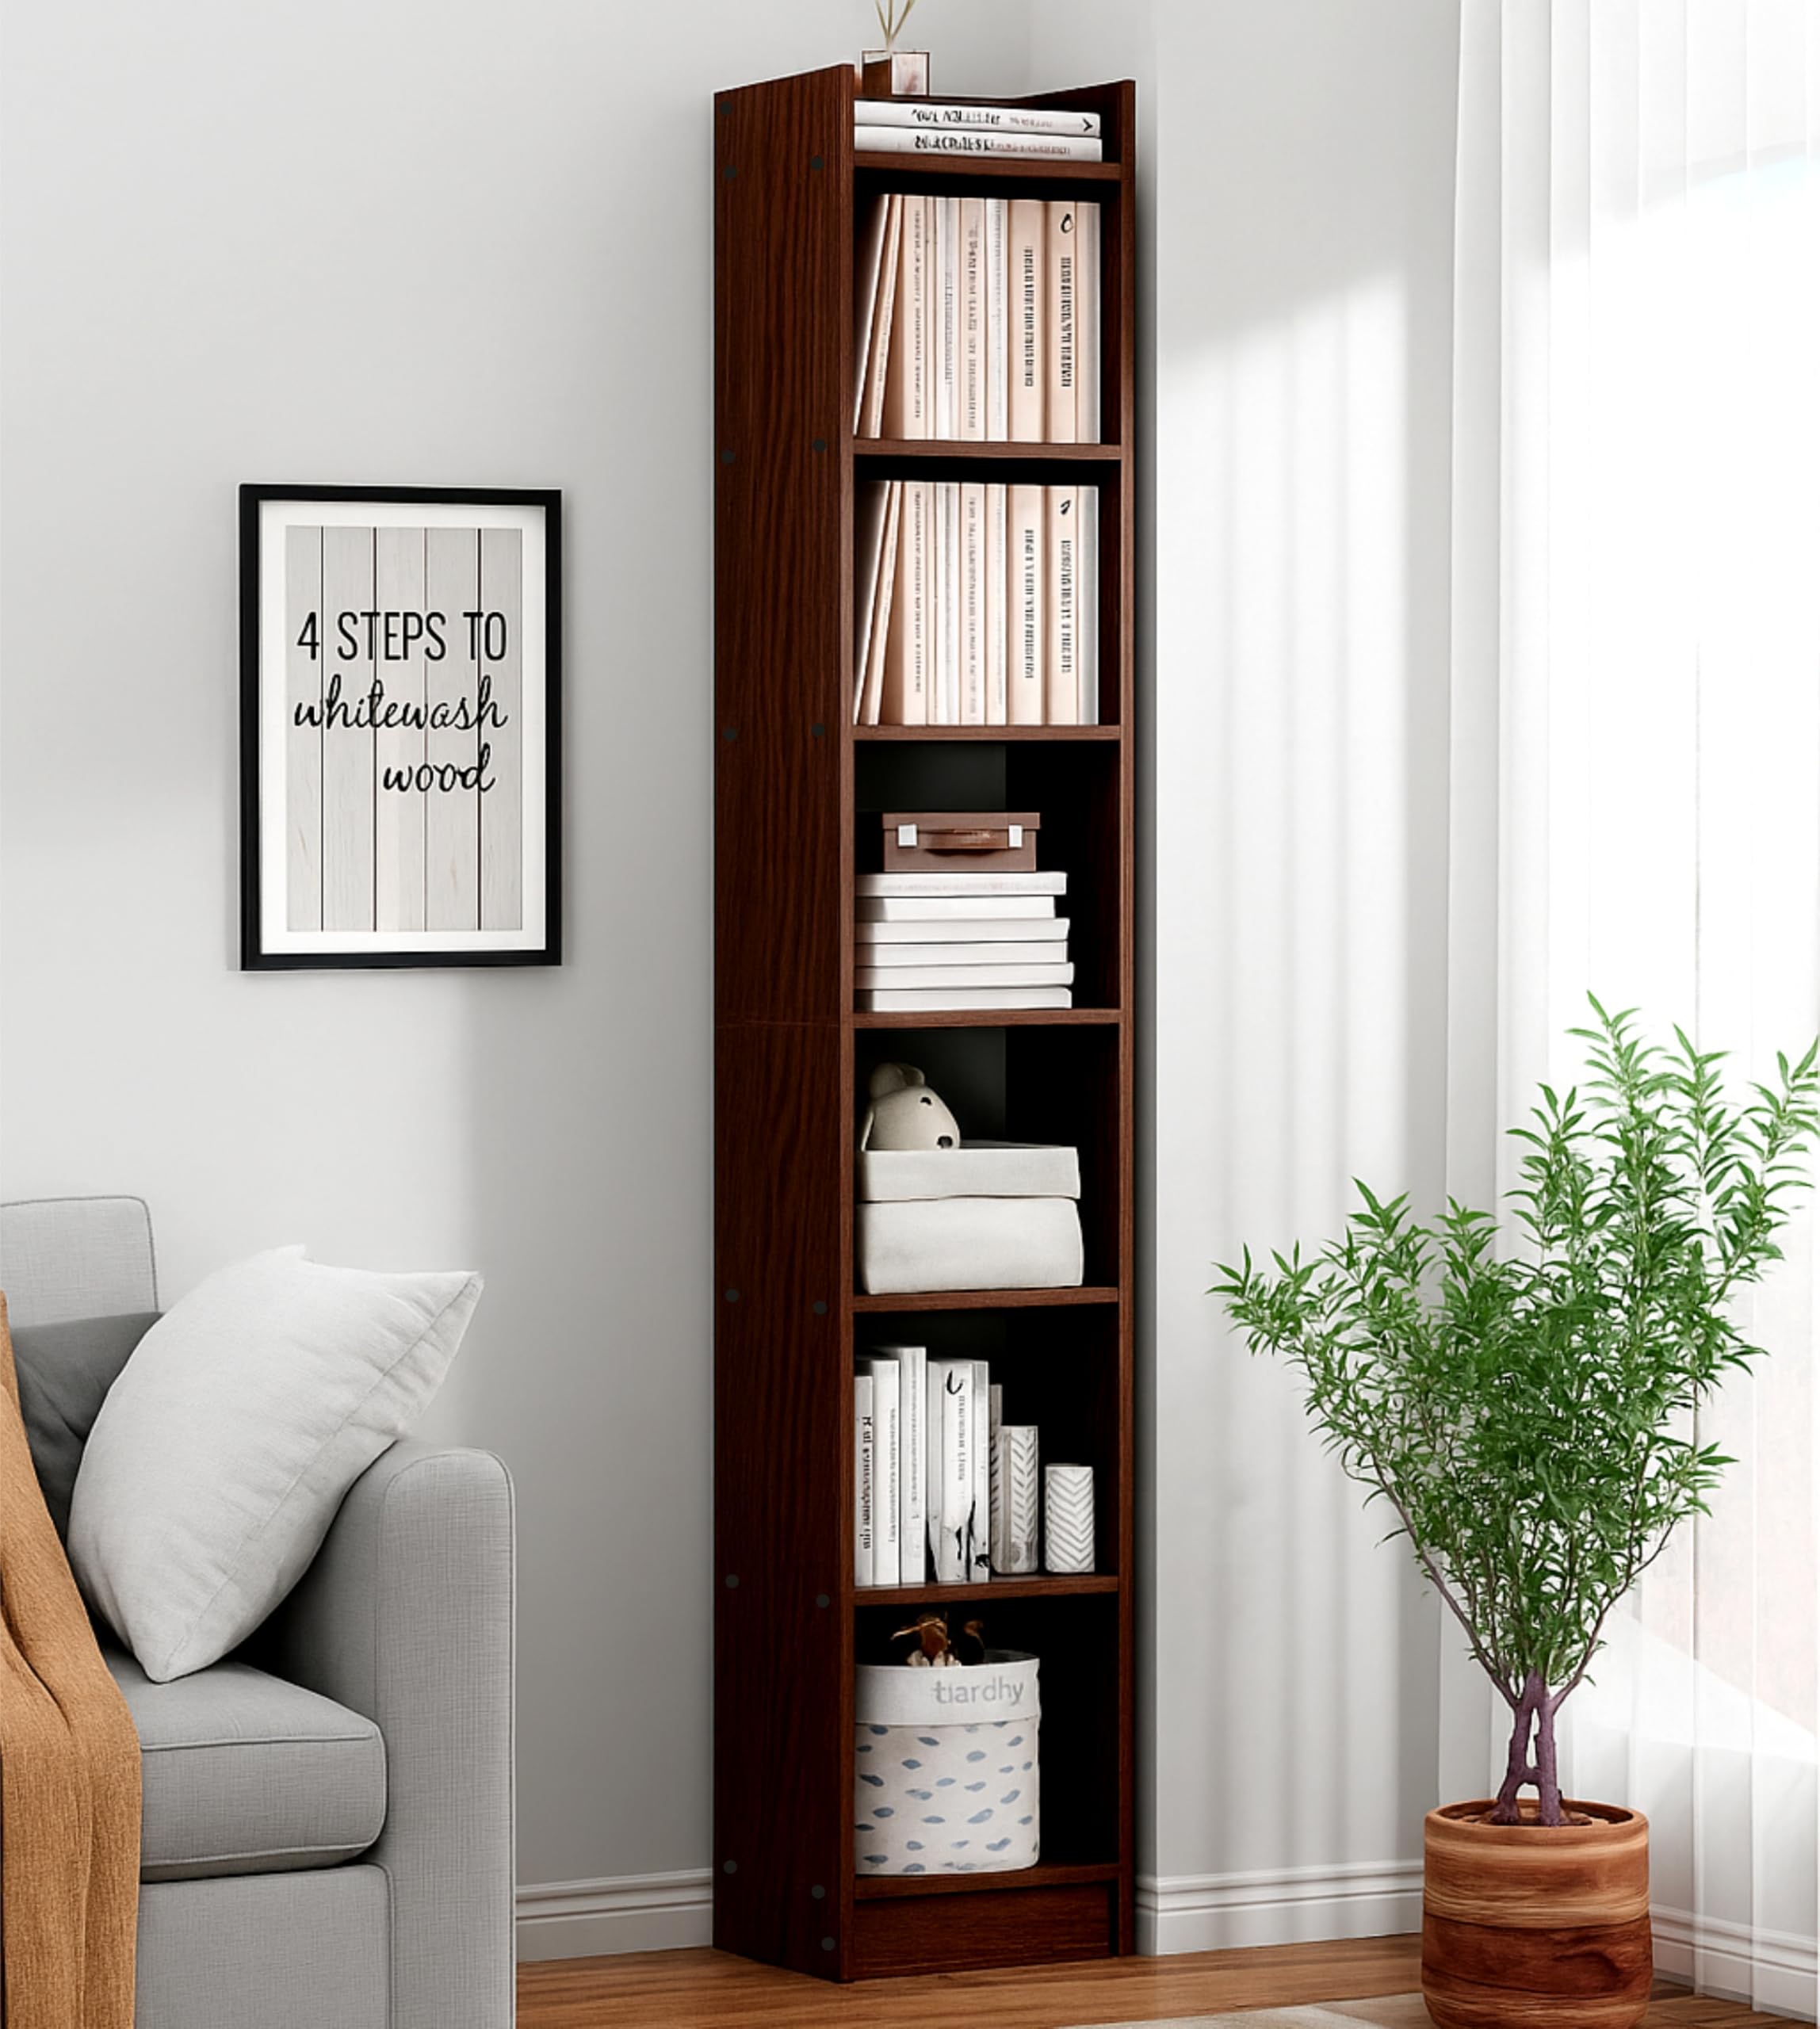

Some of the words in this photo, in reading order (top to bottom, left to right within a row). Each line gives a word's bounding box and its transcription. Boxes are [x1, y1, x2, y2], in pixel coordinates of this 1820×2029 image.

[296, 611, 320, 661] 4
[336, 611, 446, 661] STEPS
[462, 611, 507, 661] TO
[294, 674, 508, 730] whitewash
[383, 743, 496, 793] wood
